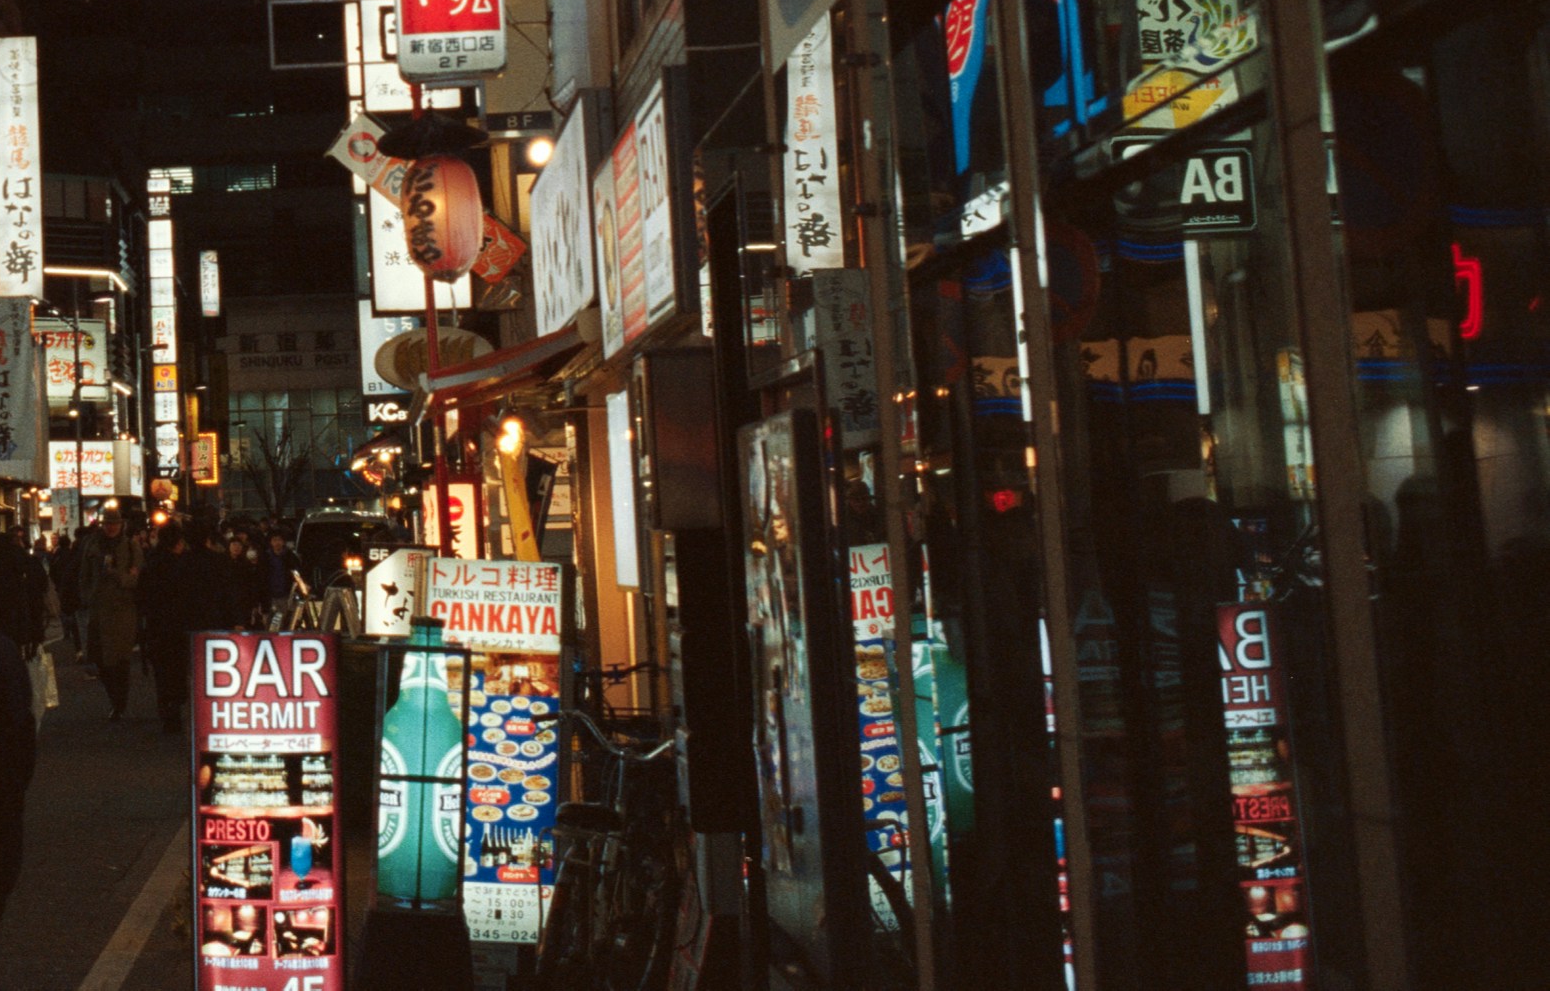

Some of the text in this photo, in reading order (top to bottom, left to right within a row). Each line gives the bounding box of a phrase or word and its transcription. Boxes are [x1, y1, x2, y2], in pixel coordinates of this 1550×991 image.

[409, 36, 495, 54] 新宿西口店
[438, 56, 469, 69] 2F
[2, 176, 38, 286] はなの舞
[239, 355, 303, 369] SHINJUKU
[368, 382, 383, 392] B1
[369, 549, 389, 560] 5F
[433, 561, 559, 592] トルコ料理
[432, 588, 559, 606] TURKISH RESTAURANT
[467, 635, 526, 650] チャンカヤ
[204, 638, 330, 698] BAR
[211, 701, 321, 730] HERMIT
[205, 819, 270, 842] PRESTO
[487, 908, 525, 920] 2:30
